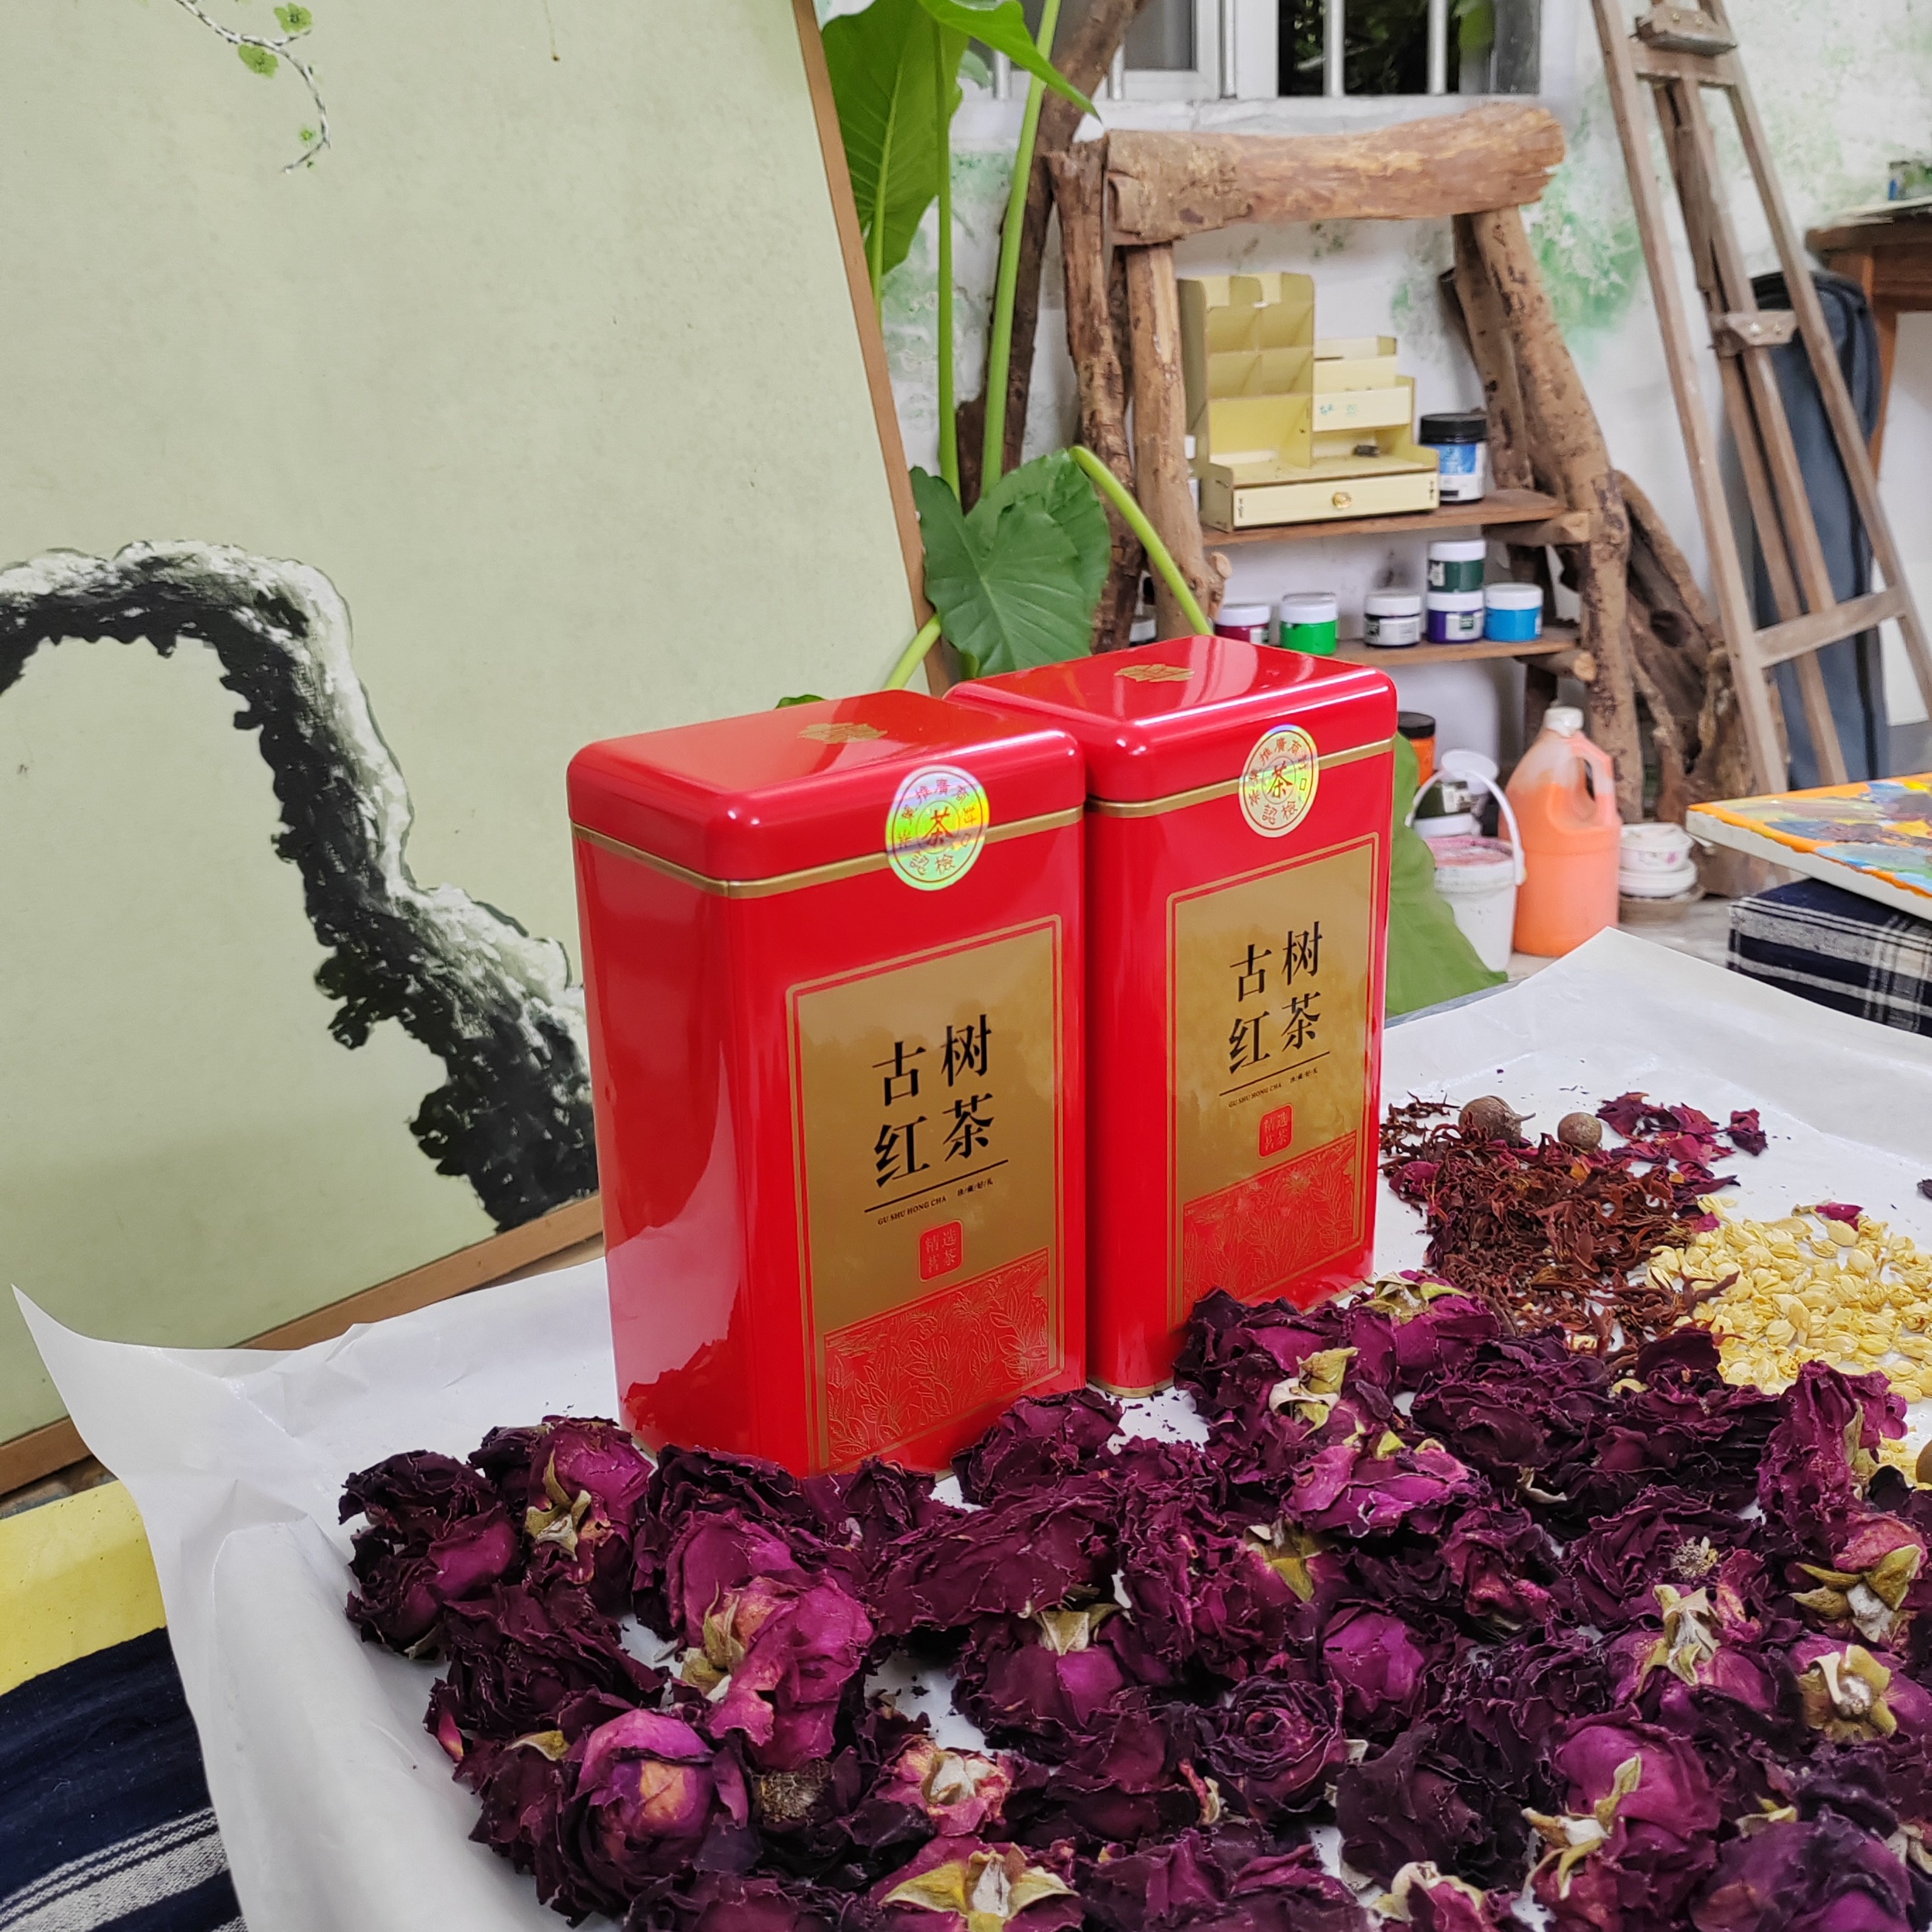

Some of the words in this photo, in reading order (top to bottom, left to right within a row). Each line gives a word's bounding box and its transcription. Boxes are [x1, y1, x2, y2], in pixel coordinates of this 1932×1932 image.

[1230, 921, 1323, 1002] 古树
[872, 1014, 992, 1106] 古树
[1229, 992, 1321, 1074] 红茶
[1238, 1095, 1250, 1104] SHU
[1251, 1087, 1269, 1099] HONG
[1270, 1082, 1282, 1092] CHA
[874, 1093, 994, 1188] 红茶
[877, 1216, 889, 1225] GU
[891, 1210, 906, 1221] SHU
[907, 1201, 930, 1215] HONG
[931, 1196, 947, 1207] CHA
